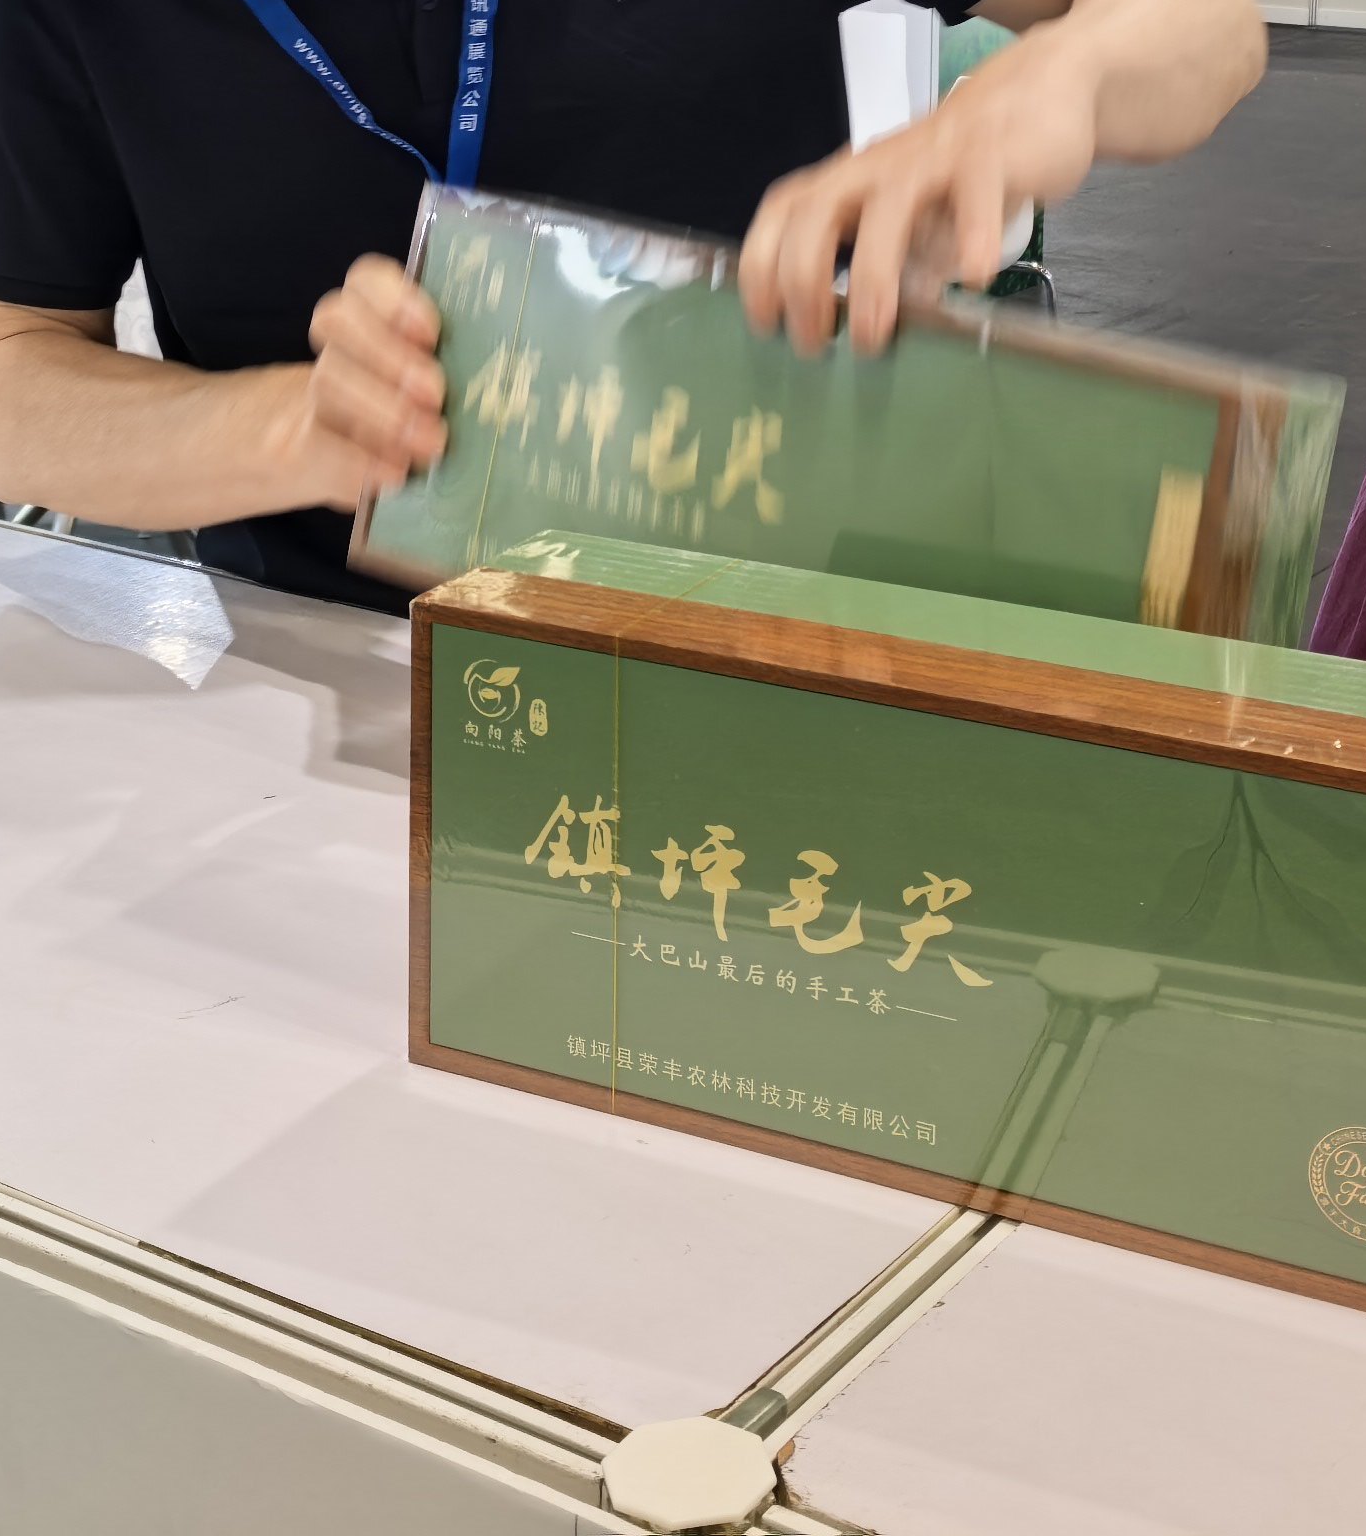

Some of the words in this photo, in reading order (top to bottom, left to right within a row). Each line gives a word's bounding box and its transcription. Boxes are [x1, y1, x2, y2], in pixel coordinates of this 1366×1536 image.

[465, 721, 527, 747] 向阳茶
[629, 935, 893, 1016] 大巴山最后的手工茶
[566, 1034, 937, 1146] 镇坪县荣丰农林科技开发有限公司
